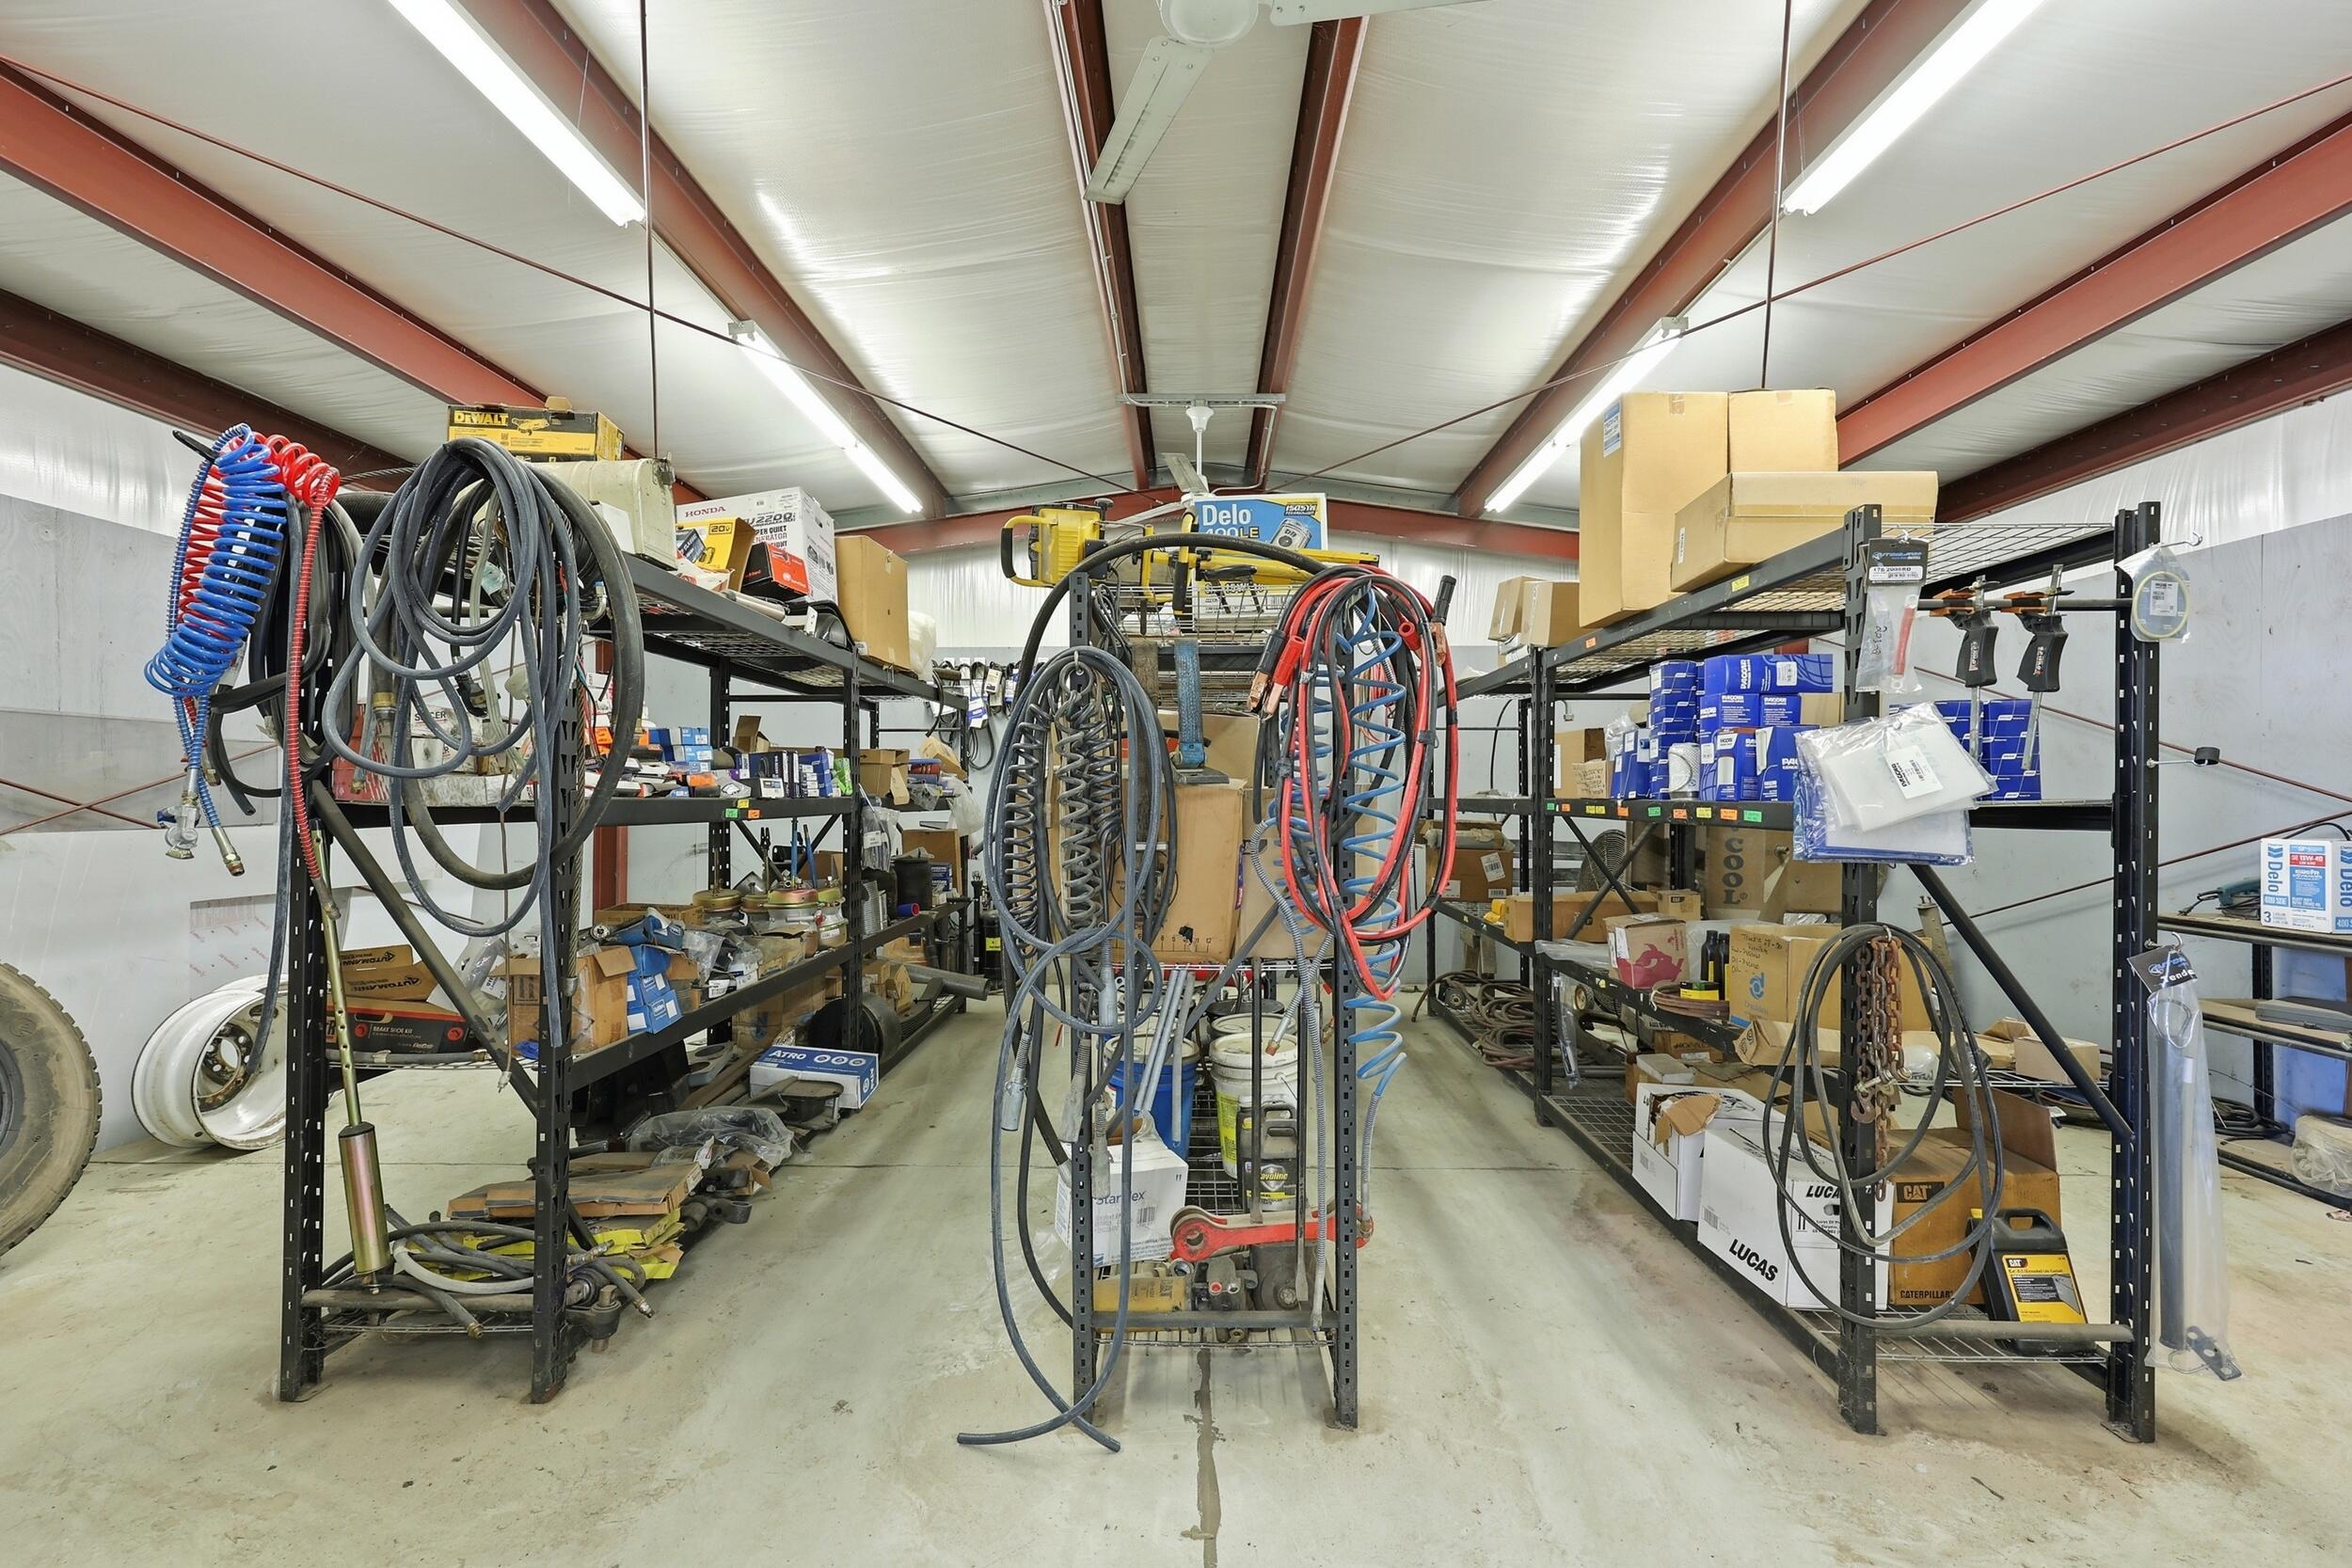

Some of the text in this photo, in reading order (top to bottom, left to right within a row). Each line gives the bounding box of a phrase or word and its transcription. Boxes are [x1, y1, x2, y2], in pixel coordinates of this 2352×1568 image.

[685, 506, 726, 518] HONDA
[1202, 503, 1252, 526] Delo
[2267, 861, 2283, 894] Delo
[2264, 911, 2272, 924] 3
[2336, 918, 2349, 928] 400
[768, 1049, 807, 1060] ATRO
[1260, 1172, 1289, 1181] avoline
[1805, 1185, 1841, 1199] LUCA
[1903, 1185, 1929, 1200] CAT
[1728, 1238, 1779, 1282] LUCAS
[1899, 1290, 1951, 1299] CATERPILLAR
